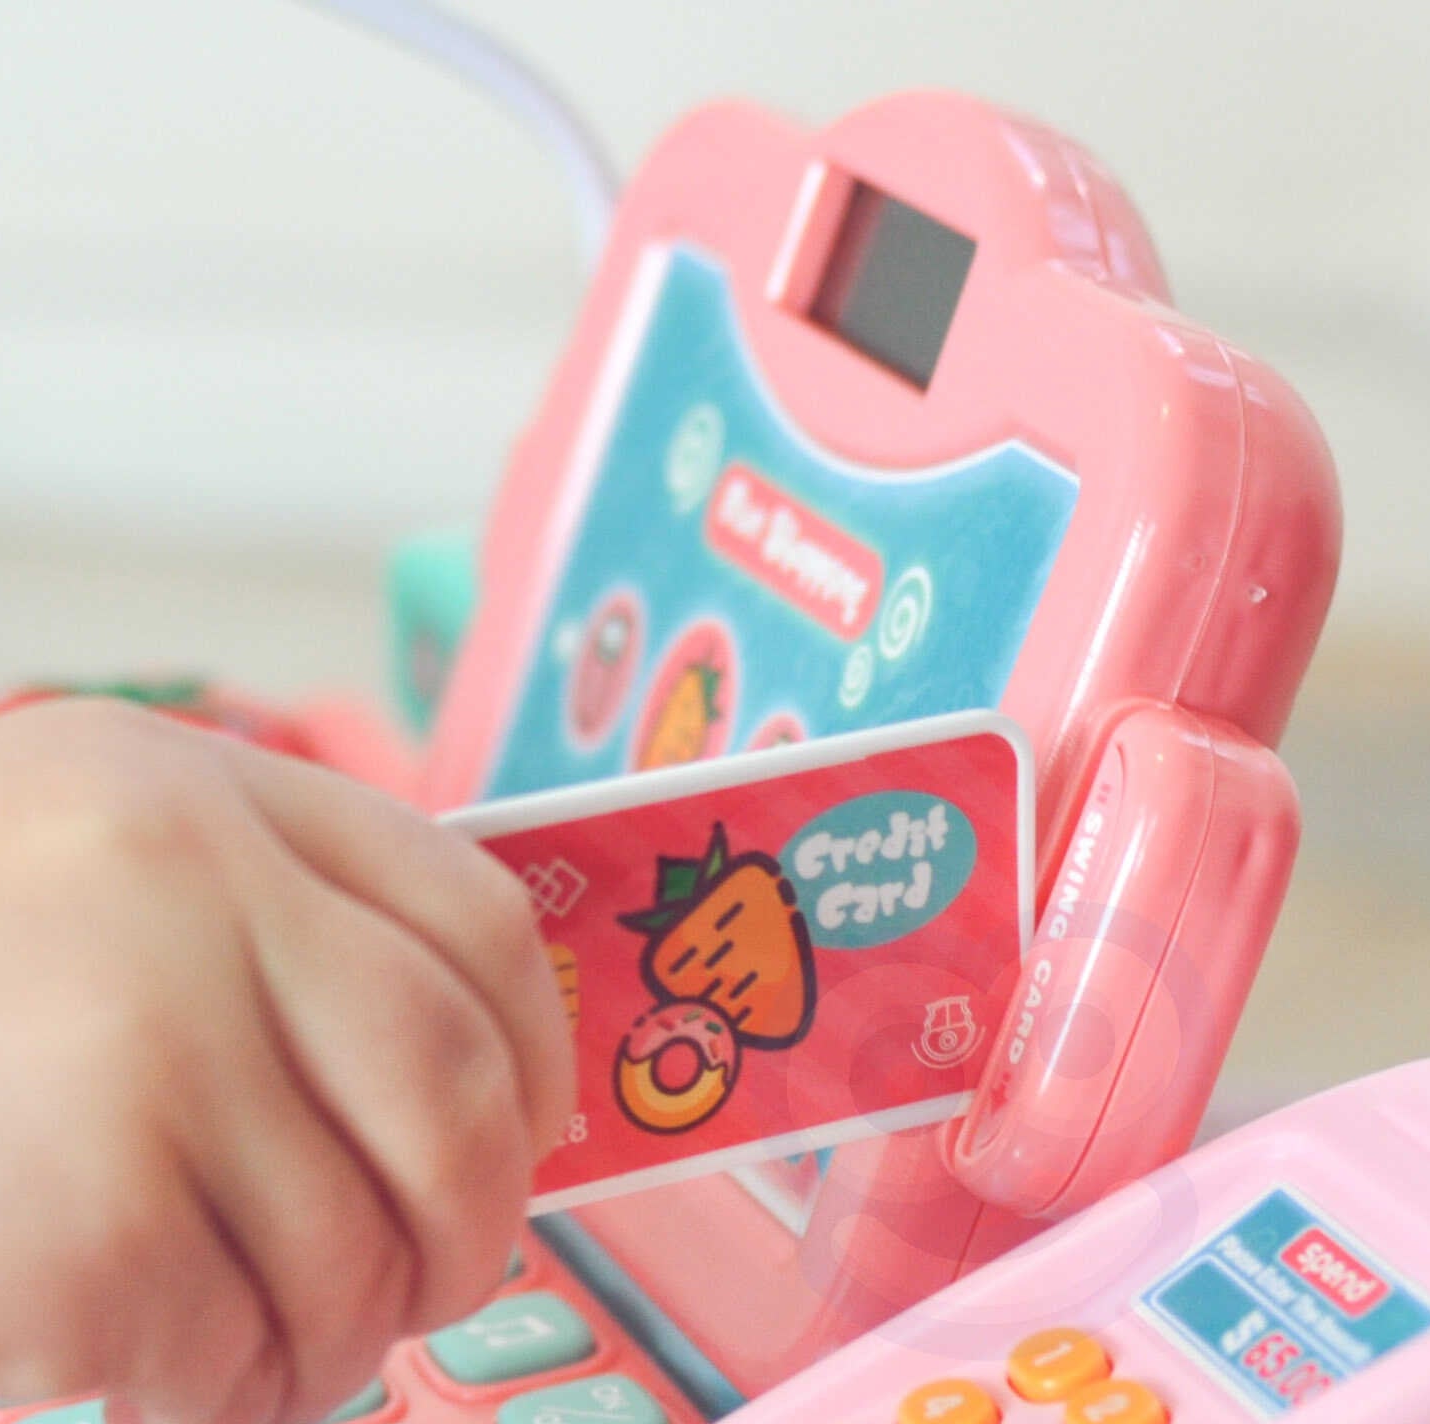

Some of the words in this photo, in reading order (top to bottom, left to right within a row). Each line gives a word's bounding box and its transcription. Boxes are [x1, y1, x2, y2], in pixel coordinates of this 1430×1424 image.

[794, 804, 949, 880] Credit
[1048, 811, 1104, 941] SWING
[816, 860, 933, 930] Card
[1008, 959, 1052, 1065] CARD
[1296, 1241, 1377, 1303] spend
[1033, 1342, 1074, 1368] 1
